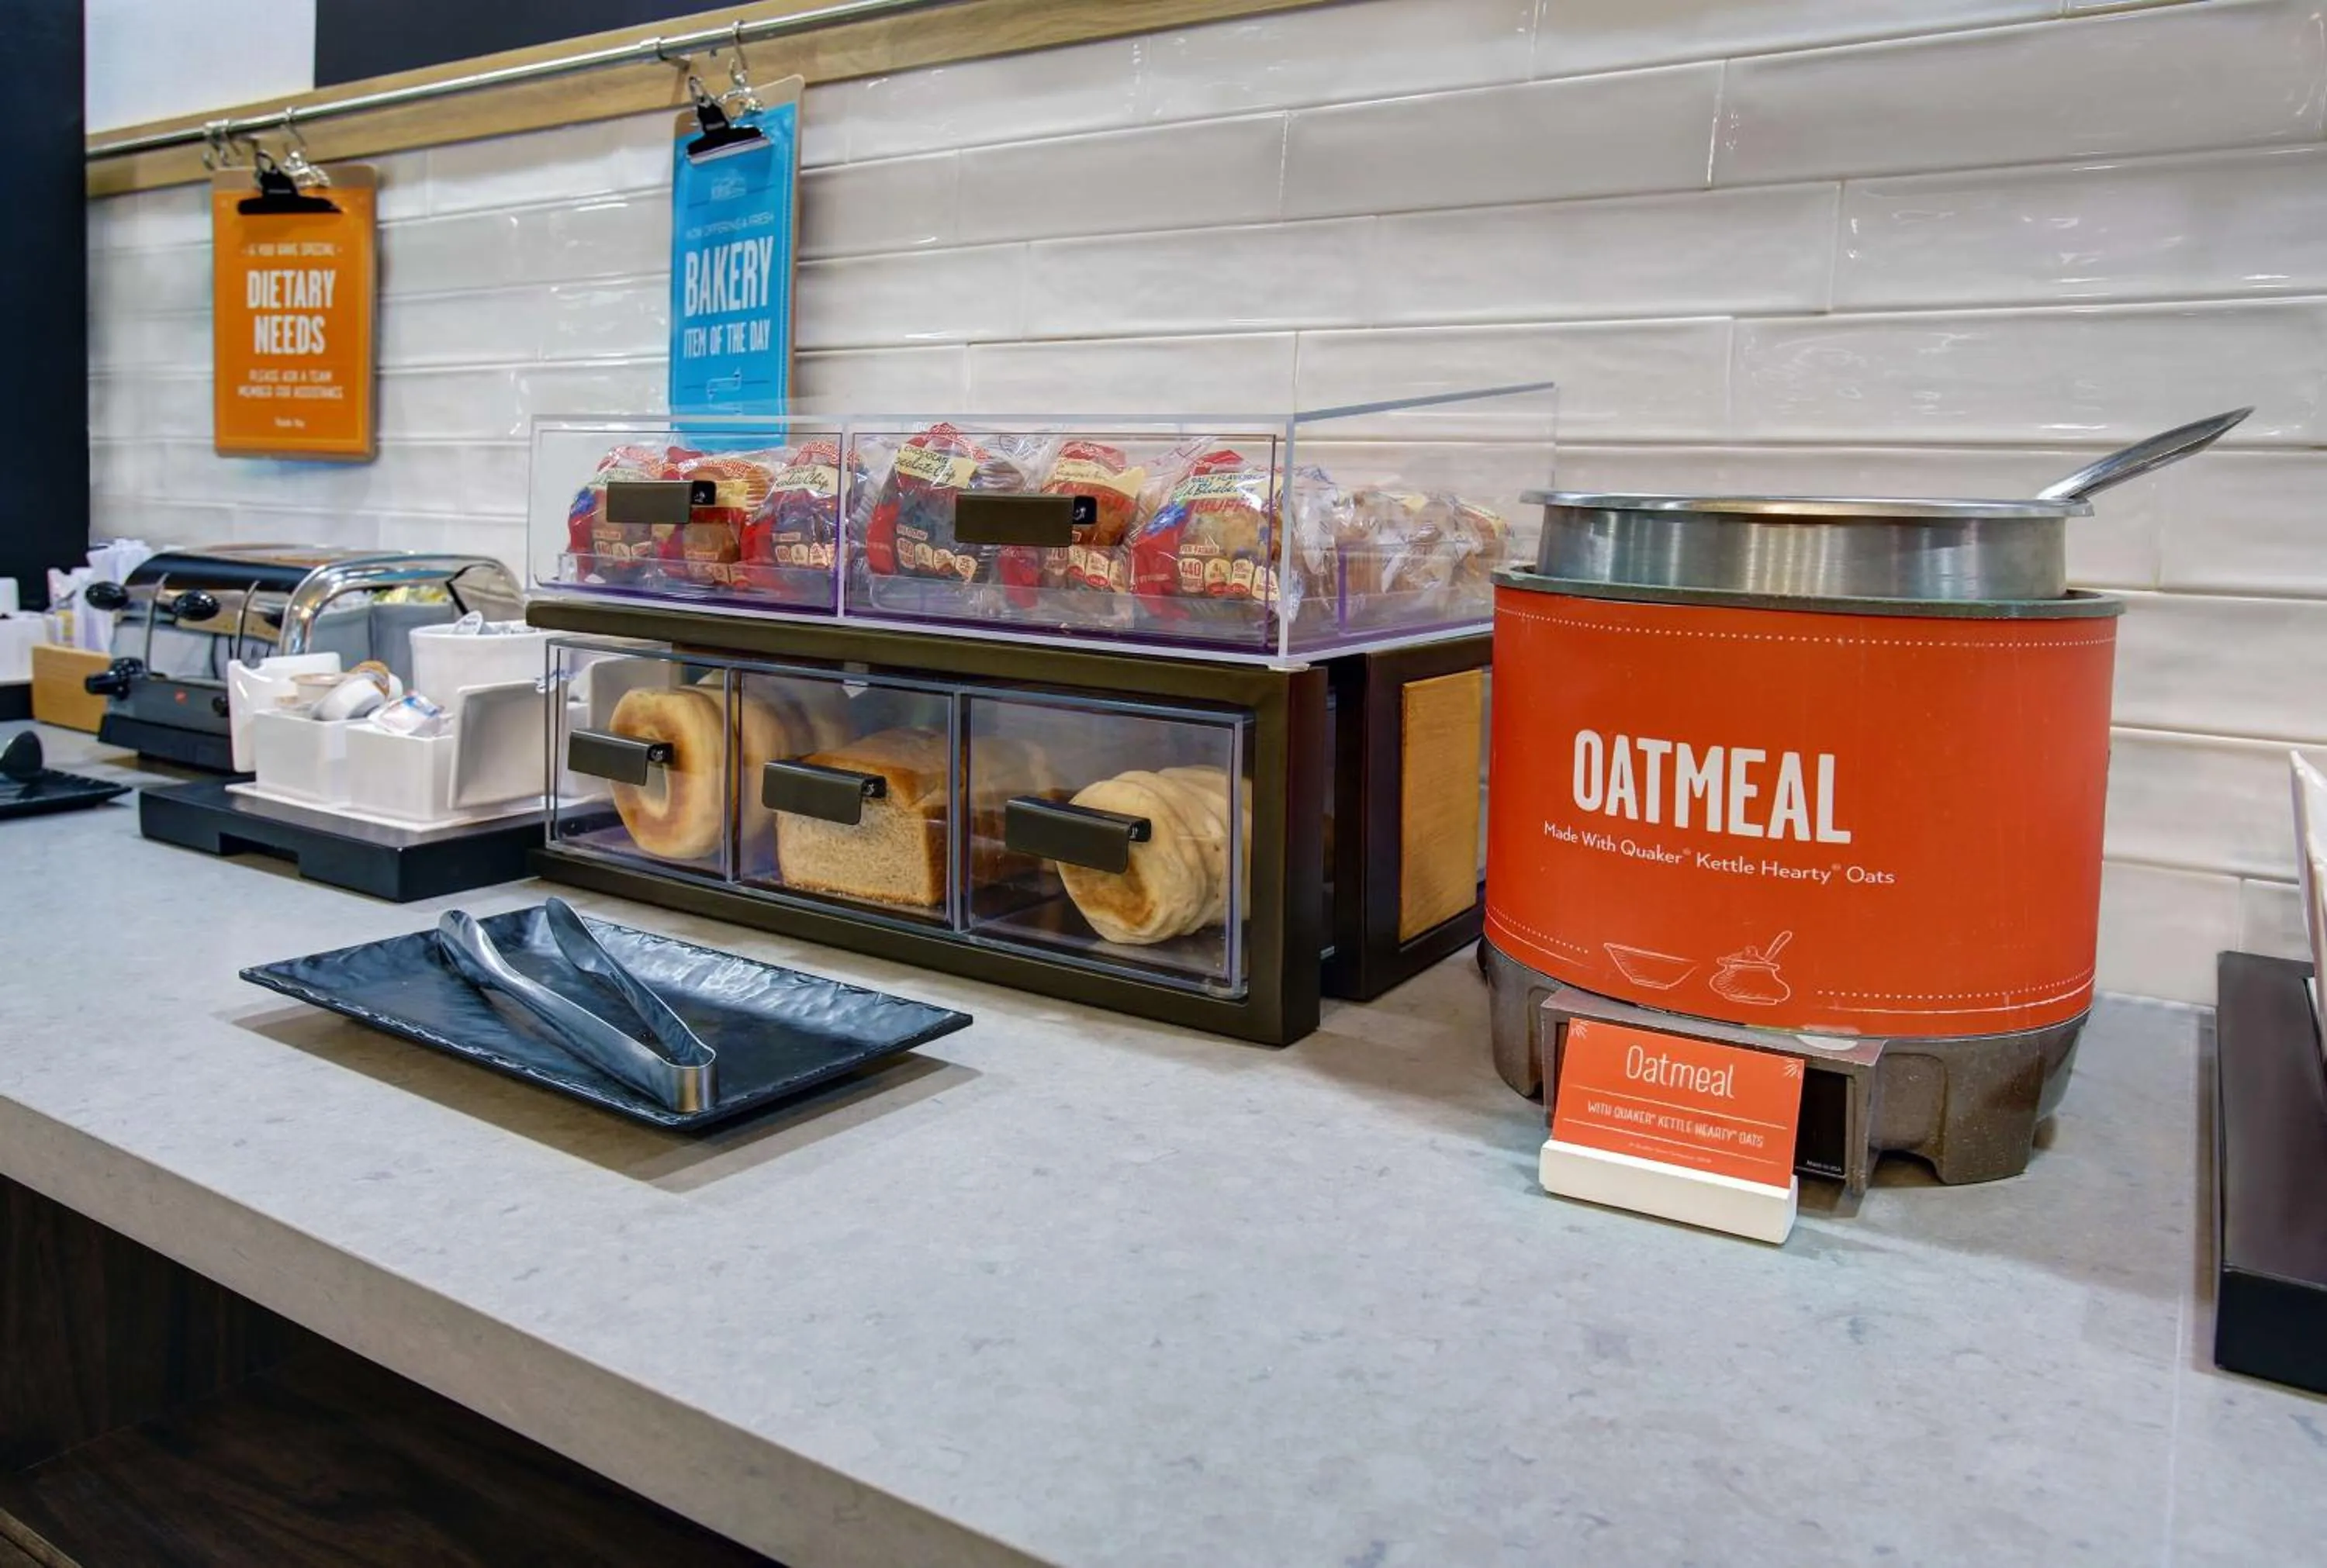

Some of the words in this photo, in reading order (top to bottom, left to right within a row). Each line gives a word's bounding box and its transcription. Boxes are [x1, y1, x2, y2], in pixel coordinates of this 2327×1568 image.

[247, 270, 336, 309] DIETARY
[684, 235, 774, 317] BAKERY
[254, 316, 326, 354] NEEDS
[683, 326, 707, 360] ITEM
[710, 324, 723, 356] OF
[727, 321, 746, 355] THE
[750, 317, 770, 352] DAY
[1572, 728, 1852, 844] OATMEAL
[1544, 820, 1578, 844] Made
[1582, 831, 1616, 853] With
[1696, 851, 1755, 875] Kettle
[1846, 865, 1896, 885] Oats
[1625, 1044, 1736, 1100] Oatmeal
[1588, 1100, 1612, 1117] WITH
[1658, 1115, 1693, 1134] KETTLE
[1738, 1131, 1765, 1148] OATS
